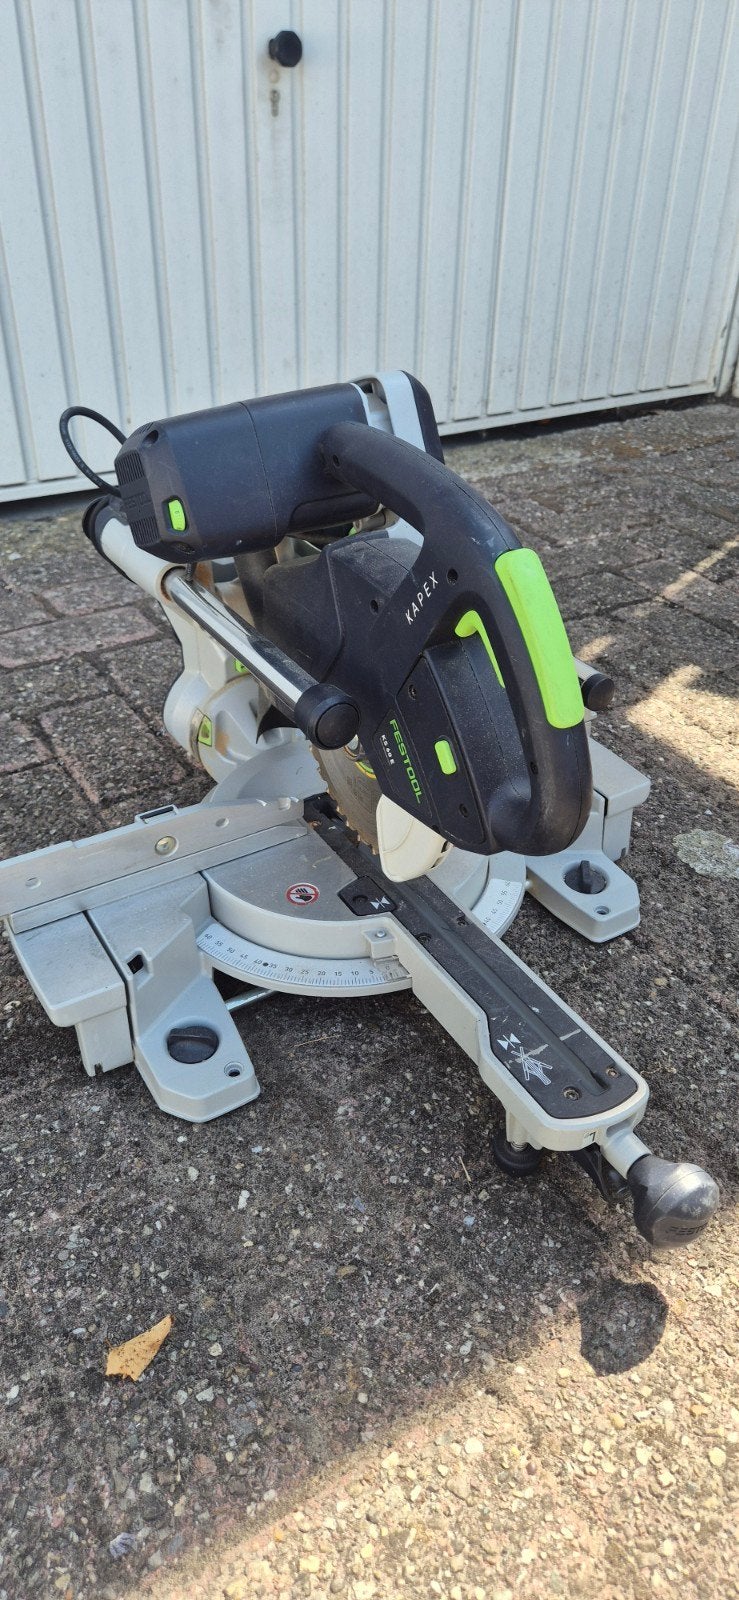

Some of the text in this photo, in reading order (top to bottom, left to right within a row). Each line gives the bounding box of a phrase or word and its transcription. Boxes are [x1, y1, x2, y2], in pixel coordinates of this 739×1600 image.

[405, 571, 438, 625] KAPEX
[381, 734, 389, 747] KS
[390, 719, 422, 804] FESTOOL
